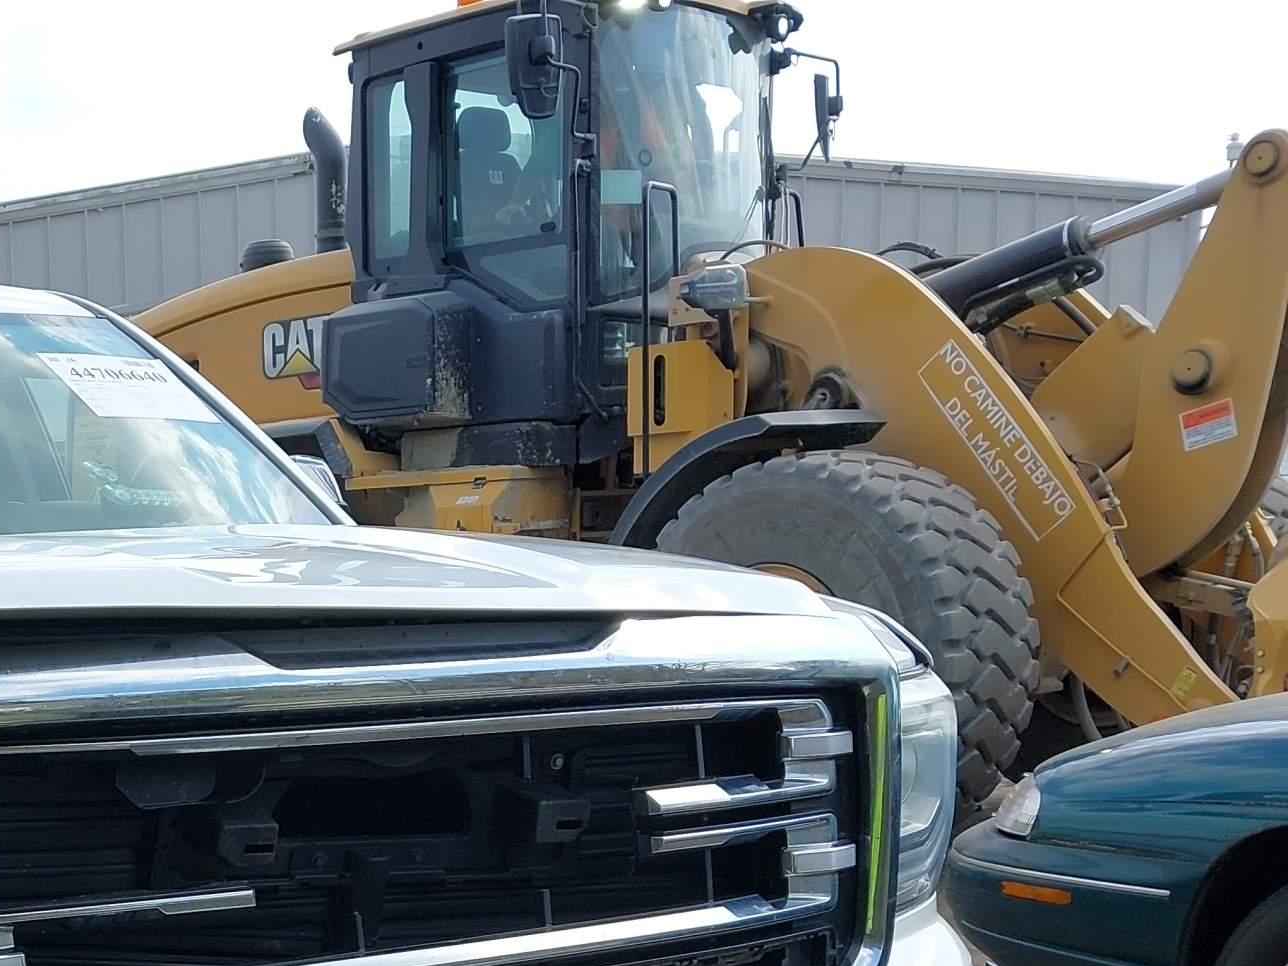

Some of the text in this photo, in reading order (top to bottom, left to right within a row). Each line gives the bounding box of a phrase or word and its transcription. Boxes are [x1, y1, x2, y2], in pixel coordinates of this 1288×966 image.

[70, 367, 168, 383] 44706640
[263, 315, 325, 378] CAT
[940, 342, 1071, 516] NO CAMINE DEBAJO
[944, 397, 1018, 502] DEL MÁSTIL
